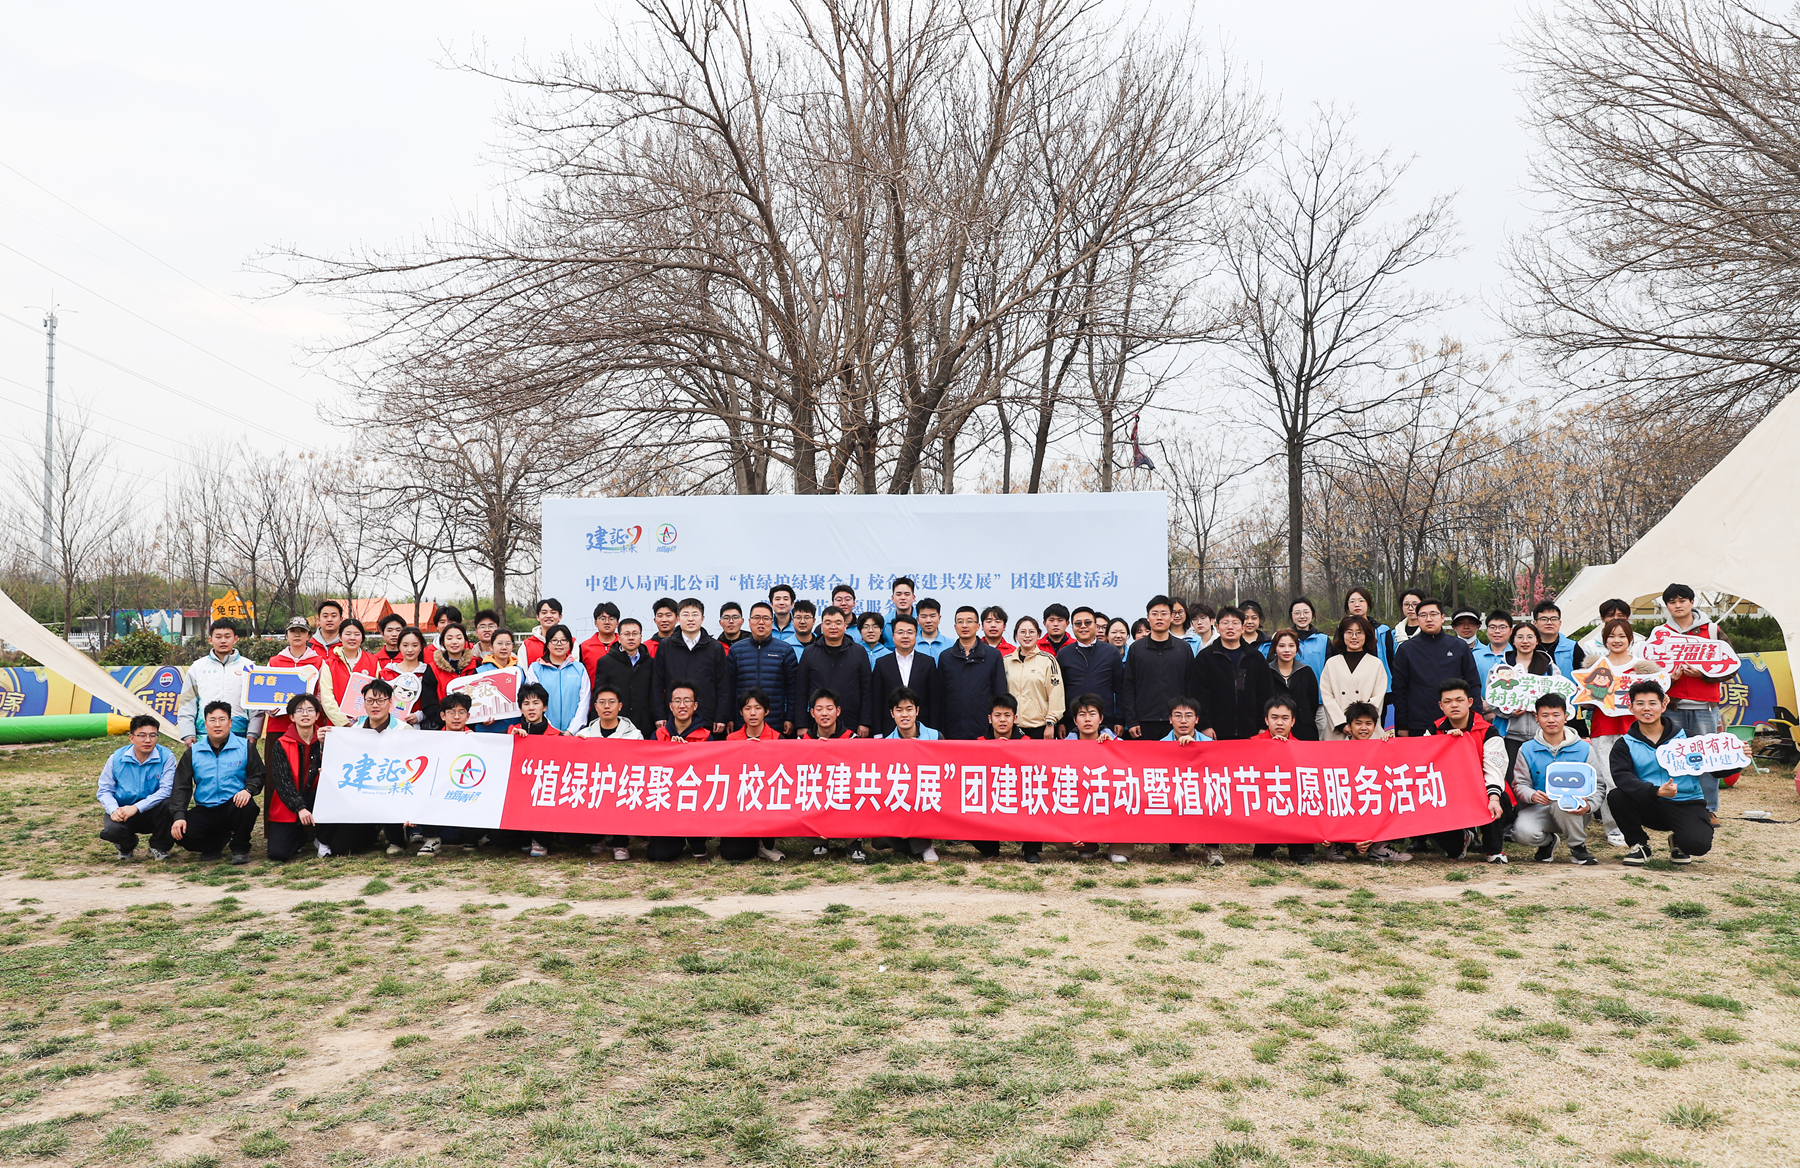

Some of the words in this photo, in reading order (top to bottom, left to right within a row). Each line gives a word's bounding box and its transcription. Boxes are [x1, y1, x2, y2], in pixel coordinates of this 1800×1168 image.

[1670, 643, 1718, 661] 学雷锋
[1675, 737, 1741, 757] 文明有礼
[520, 758, 731, 812] “植绿护绿聚合力
